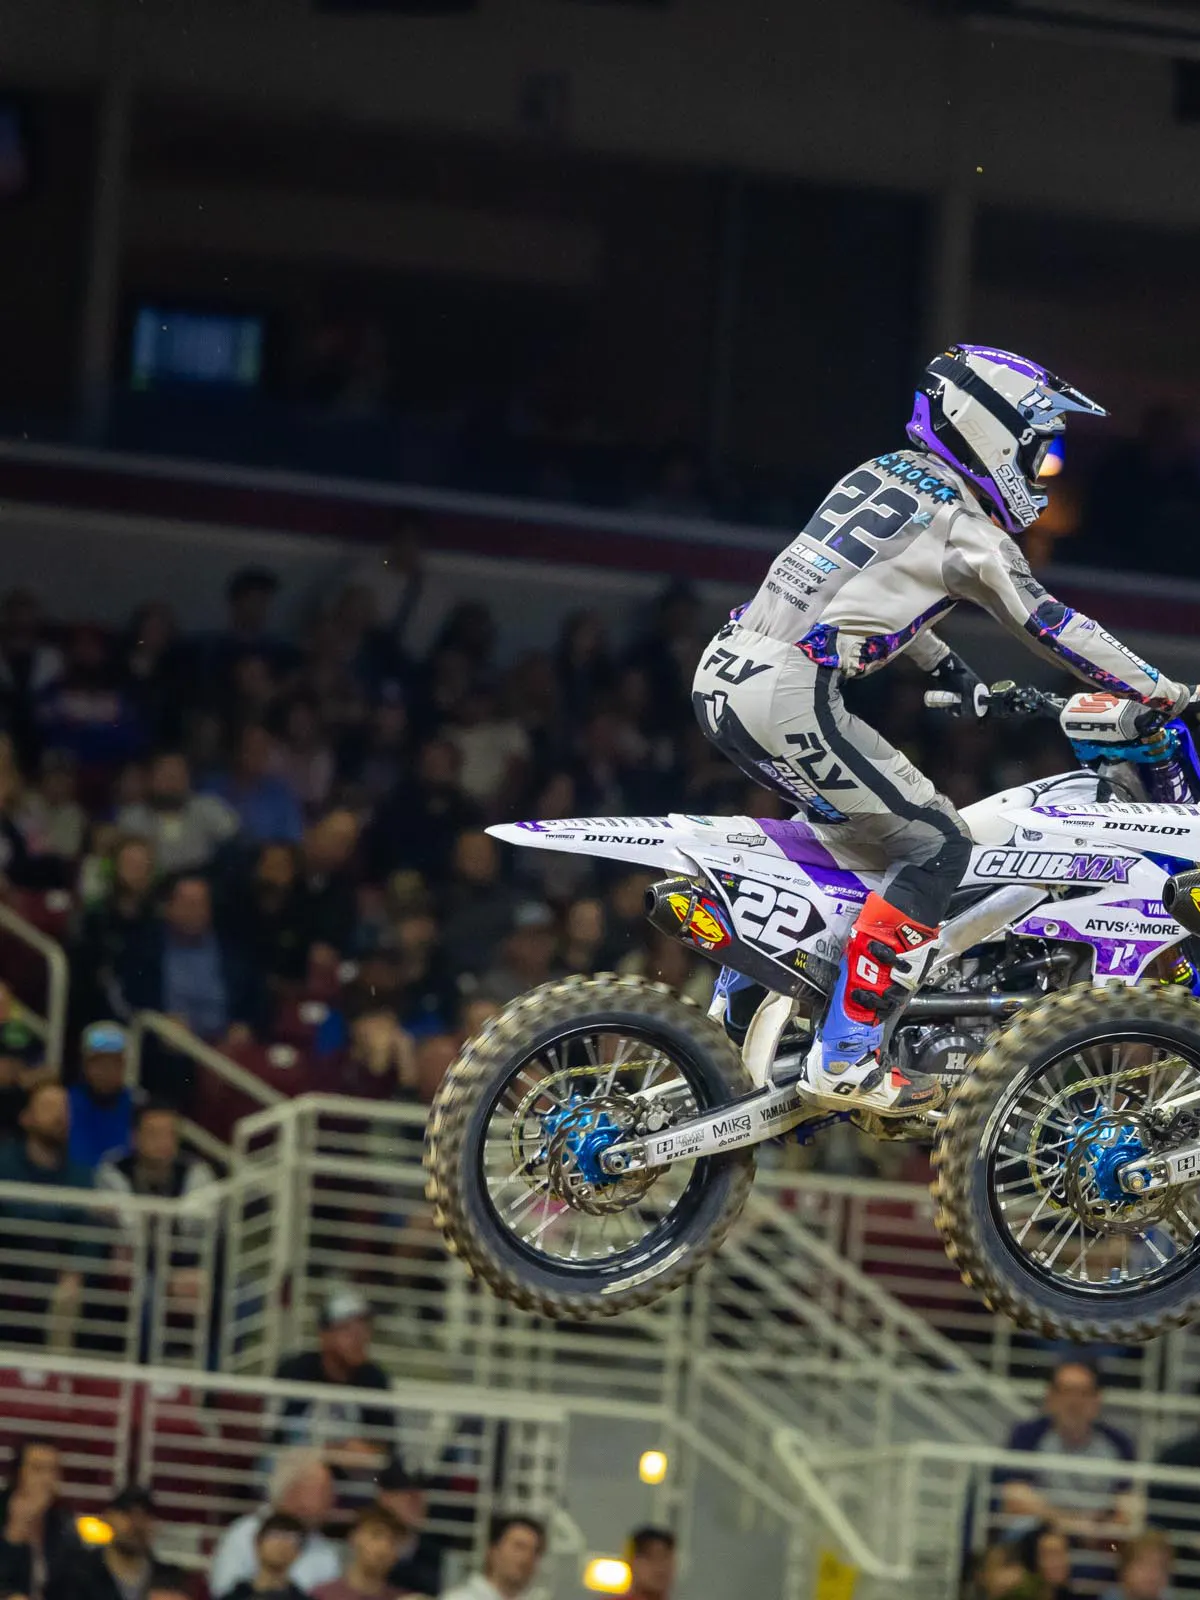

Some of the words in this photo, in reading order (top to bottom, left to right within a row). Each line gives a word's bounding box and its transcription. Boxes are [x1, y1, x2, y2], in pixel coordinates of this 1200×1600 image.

[877, 453, 957, 503] CHOCK
[802, 468, 920, 572] 22
[773, 567, 819, 596] STUSSY
[782, 556, 827, 585] PAULSON
[765, 580, 811, 613] ATVSMORE
[703, 647, 774, 685] FLY
[785, 732, 860, 790] FLY
[583, 834, 664, 846] DUNLOP
[1103, 821, 1191, 836] DUNLOP
[974, 849, 1142, 885] CLUBMX
[732, 879, 812, 951] 22
[1146, 902, 1168, 916] YAM
[666, 1146, 702, 1161] EXCEL
